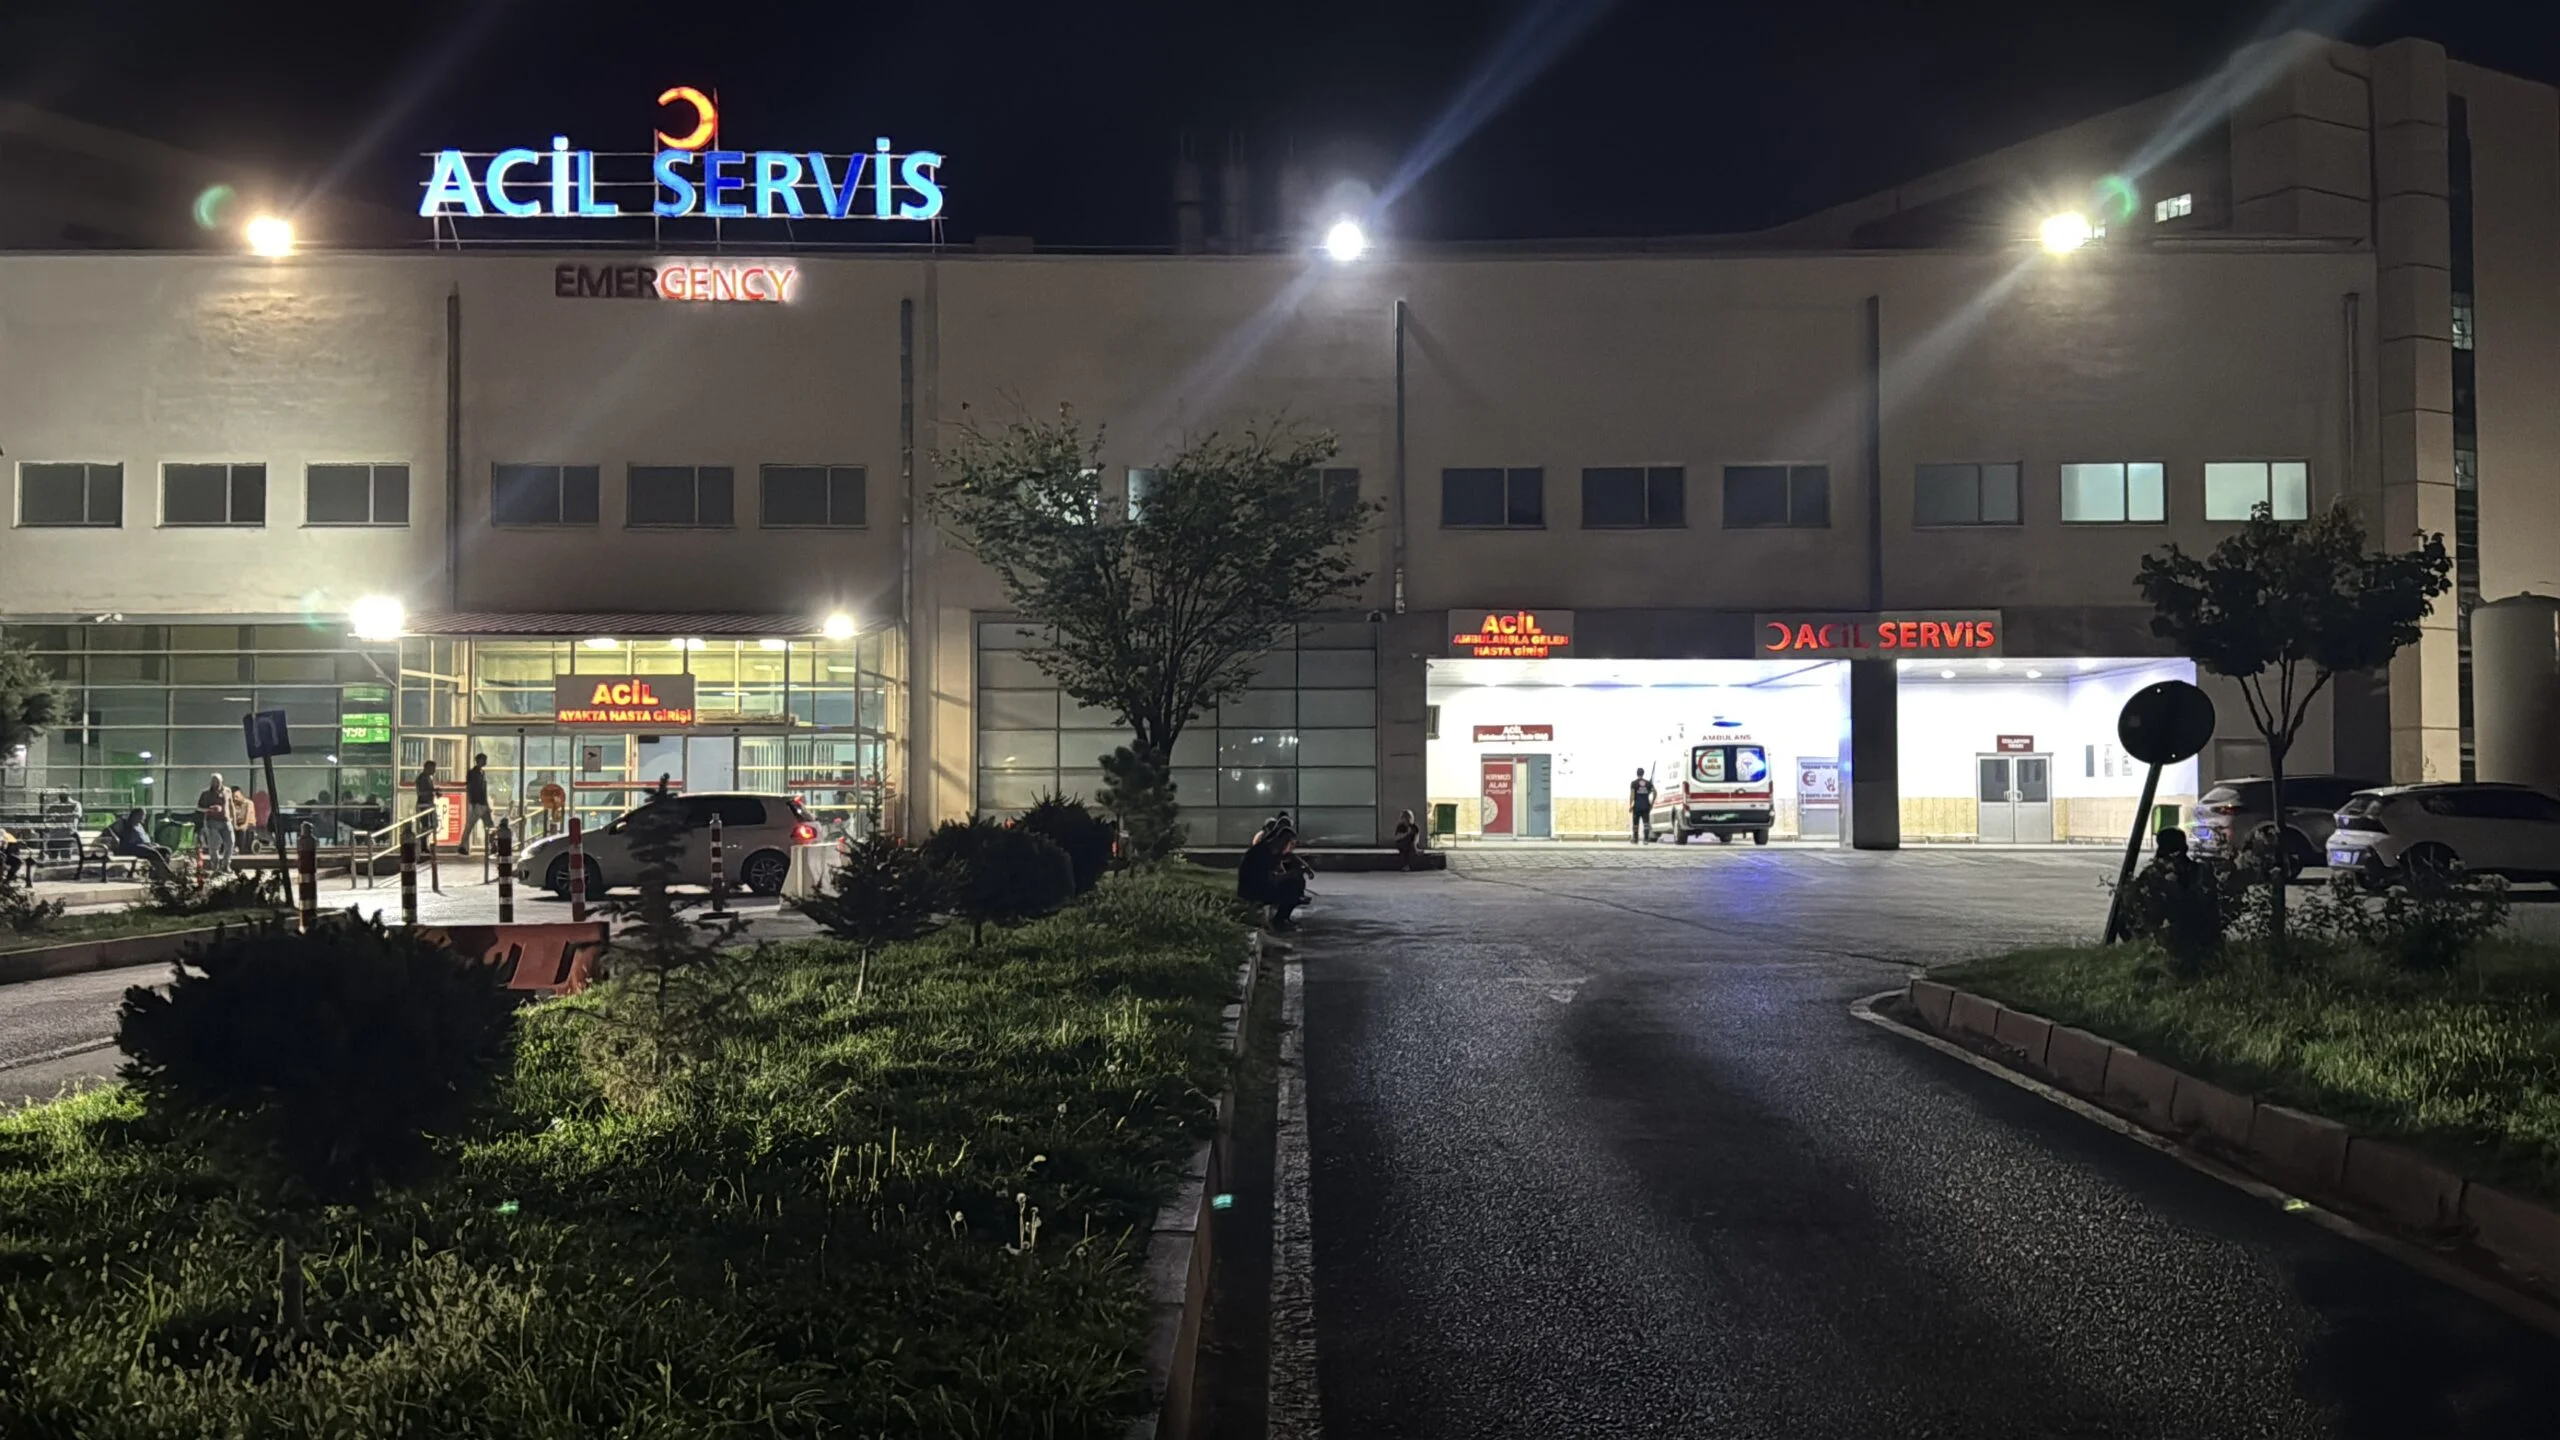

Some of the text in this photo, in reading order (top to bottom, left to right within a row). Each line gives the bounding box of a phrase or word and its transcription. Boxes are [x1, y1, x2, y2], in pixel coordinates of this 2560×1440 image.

[419, 135, 944, 219] ACİL SERVİS
[554, 265, 793, 301] EMERGENCY
[1481, 610, 1542, 634] ACİL
[1453, 634, 1570, 645] AMBULANSLA GELEN
[1473, 645, 1549, 658] HASTA GİRİŞİ
[591, 678, 660, 705] ACİL
[558, 708, 693, 724] AYAKTA HASTA GİRİŞİ
